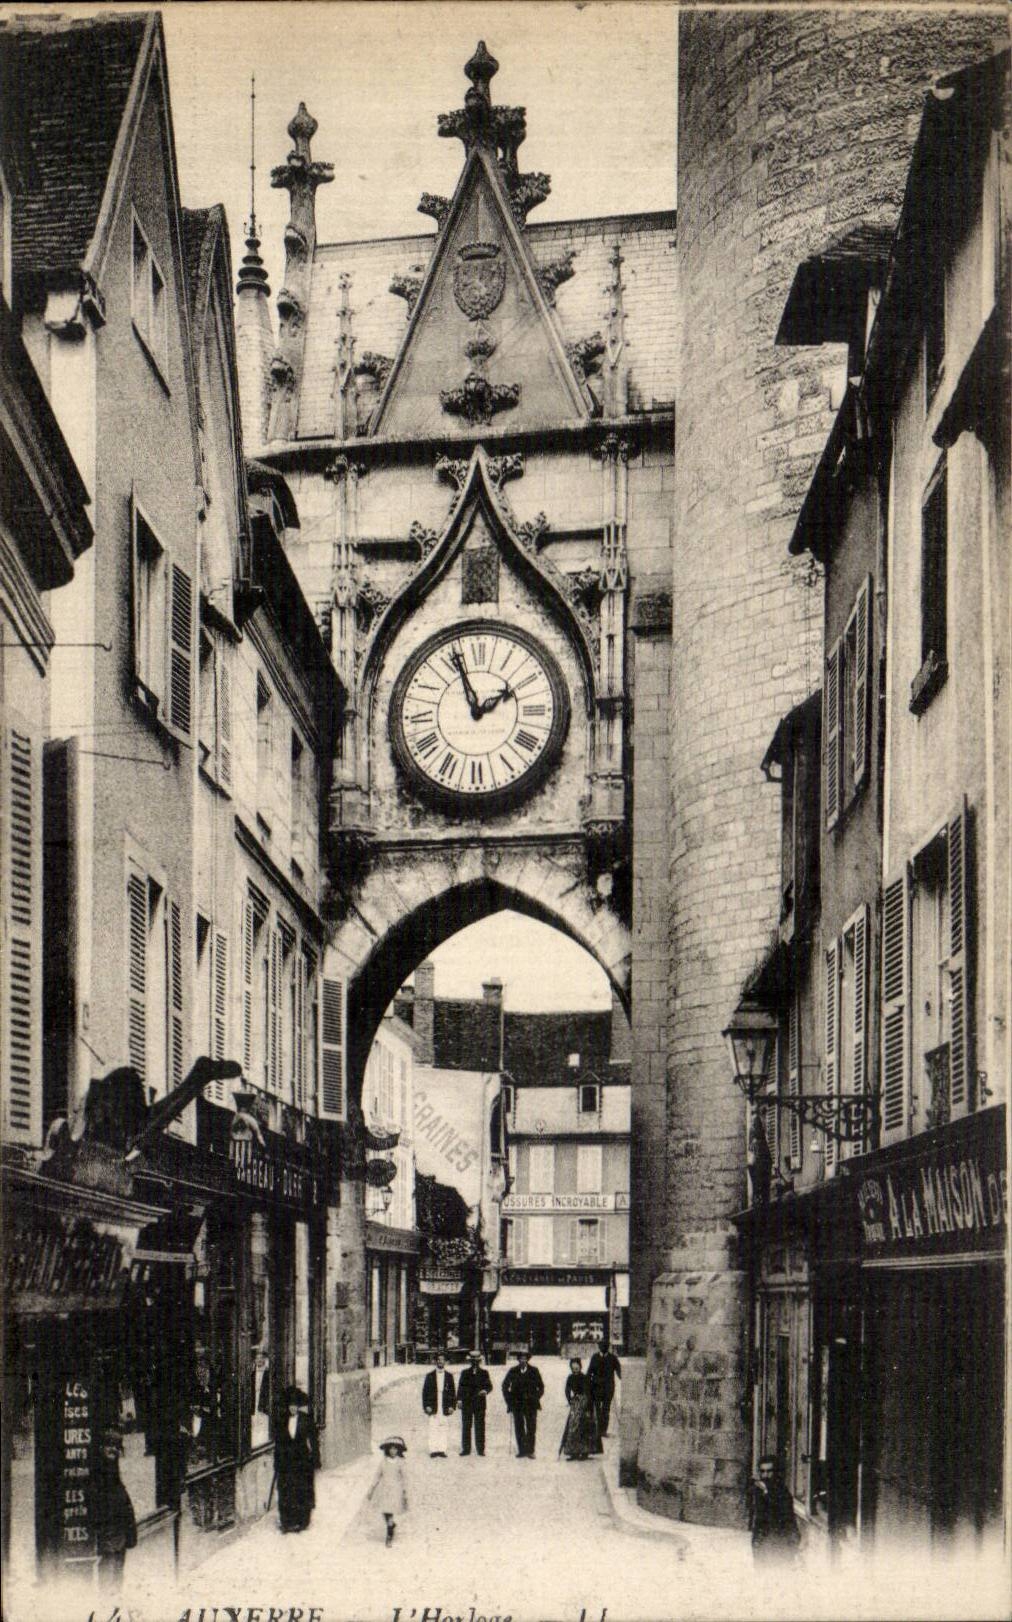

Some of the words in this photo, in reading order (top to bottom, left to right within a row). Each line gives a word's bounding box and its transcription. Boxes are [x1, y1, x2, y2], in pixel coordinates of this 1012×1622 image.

[552, 1195, 608, 1208] INCROYABLE
[886, 1174, 902, 1240] A
[901, 1189, 924, 1239] LA
[920, 1158, 988, 1235] MAISON
